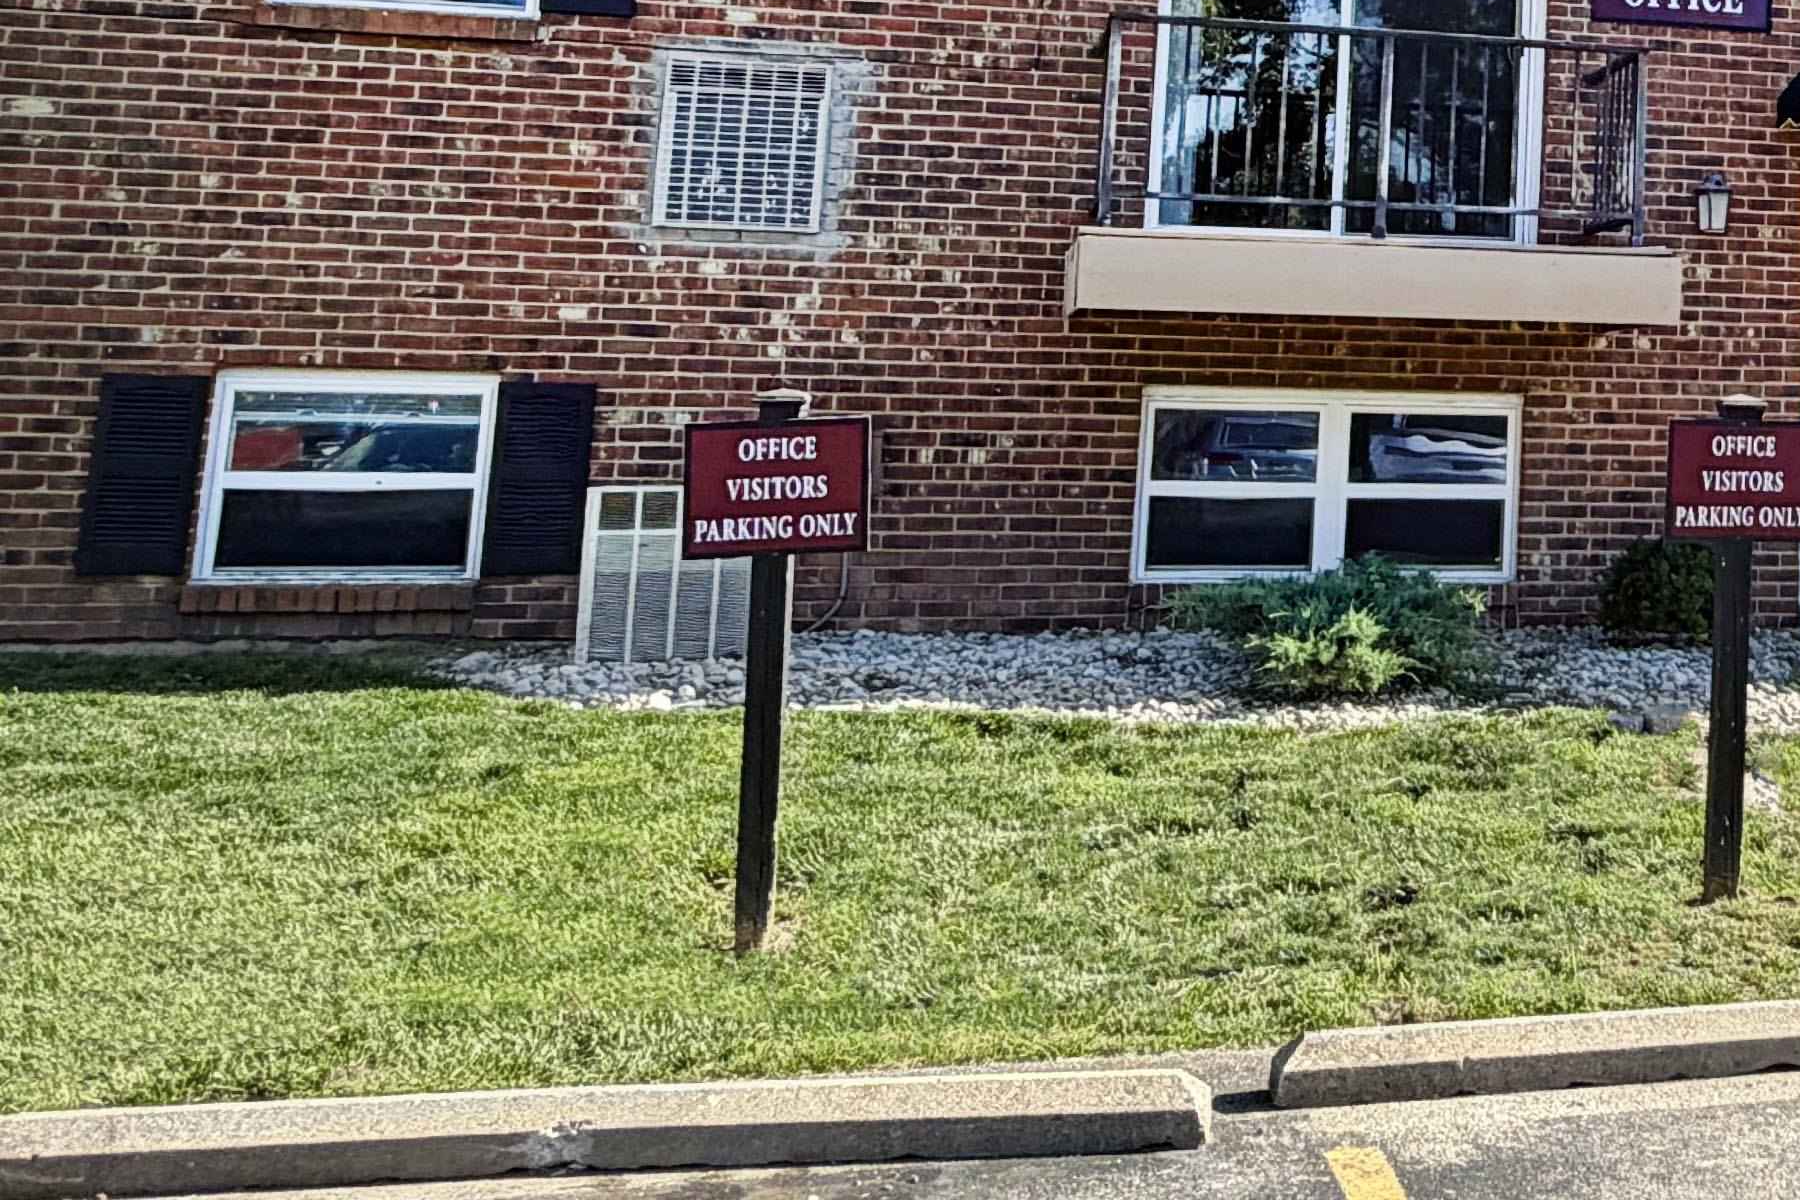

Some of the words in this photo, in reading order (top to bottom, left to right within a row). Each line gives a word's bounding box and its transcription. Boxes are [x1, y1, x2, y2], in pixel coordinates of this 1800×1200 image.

[738, 436, 817, 462] OFFICE
[1711, 435, 1777, 457] OFFICE
[726, 474, 828, 501] VISITORS
[1702, 470, 1784, 492] VISITORS
[694, 515, 793, 543] PARKING
[799, 512, 858, 538] ONLY
[1675, 505, 1754, 527] PARKING
